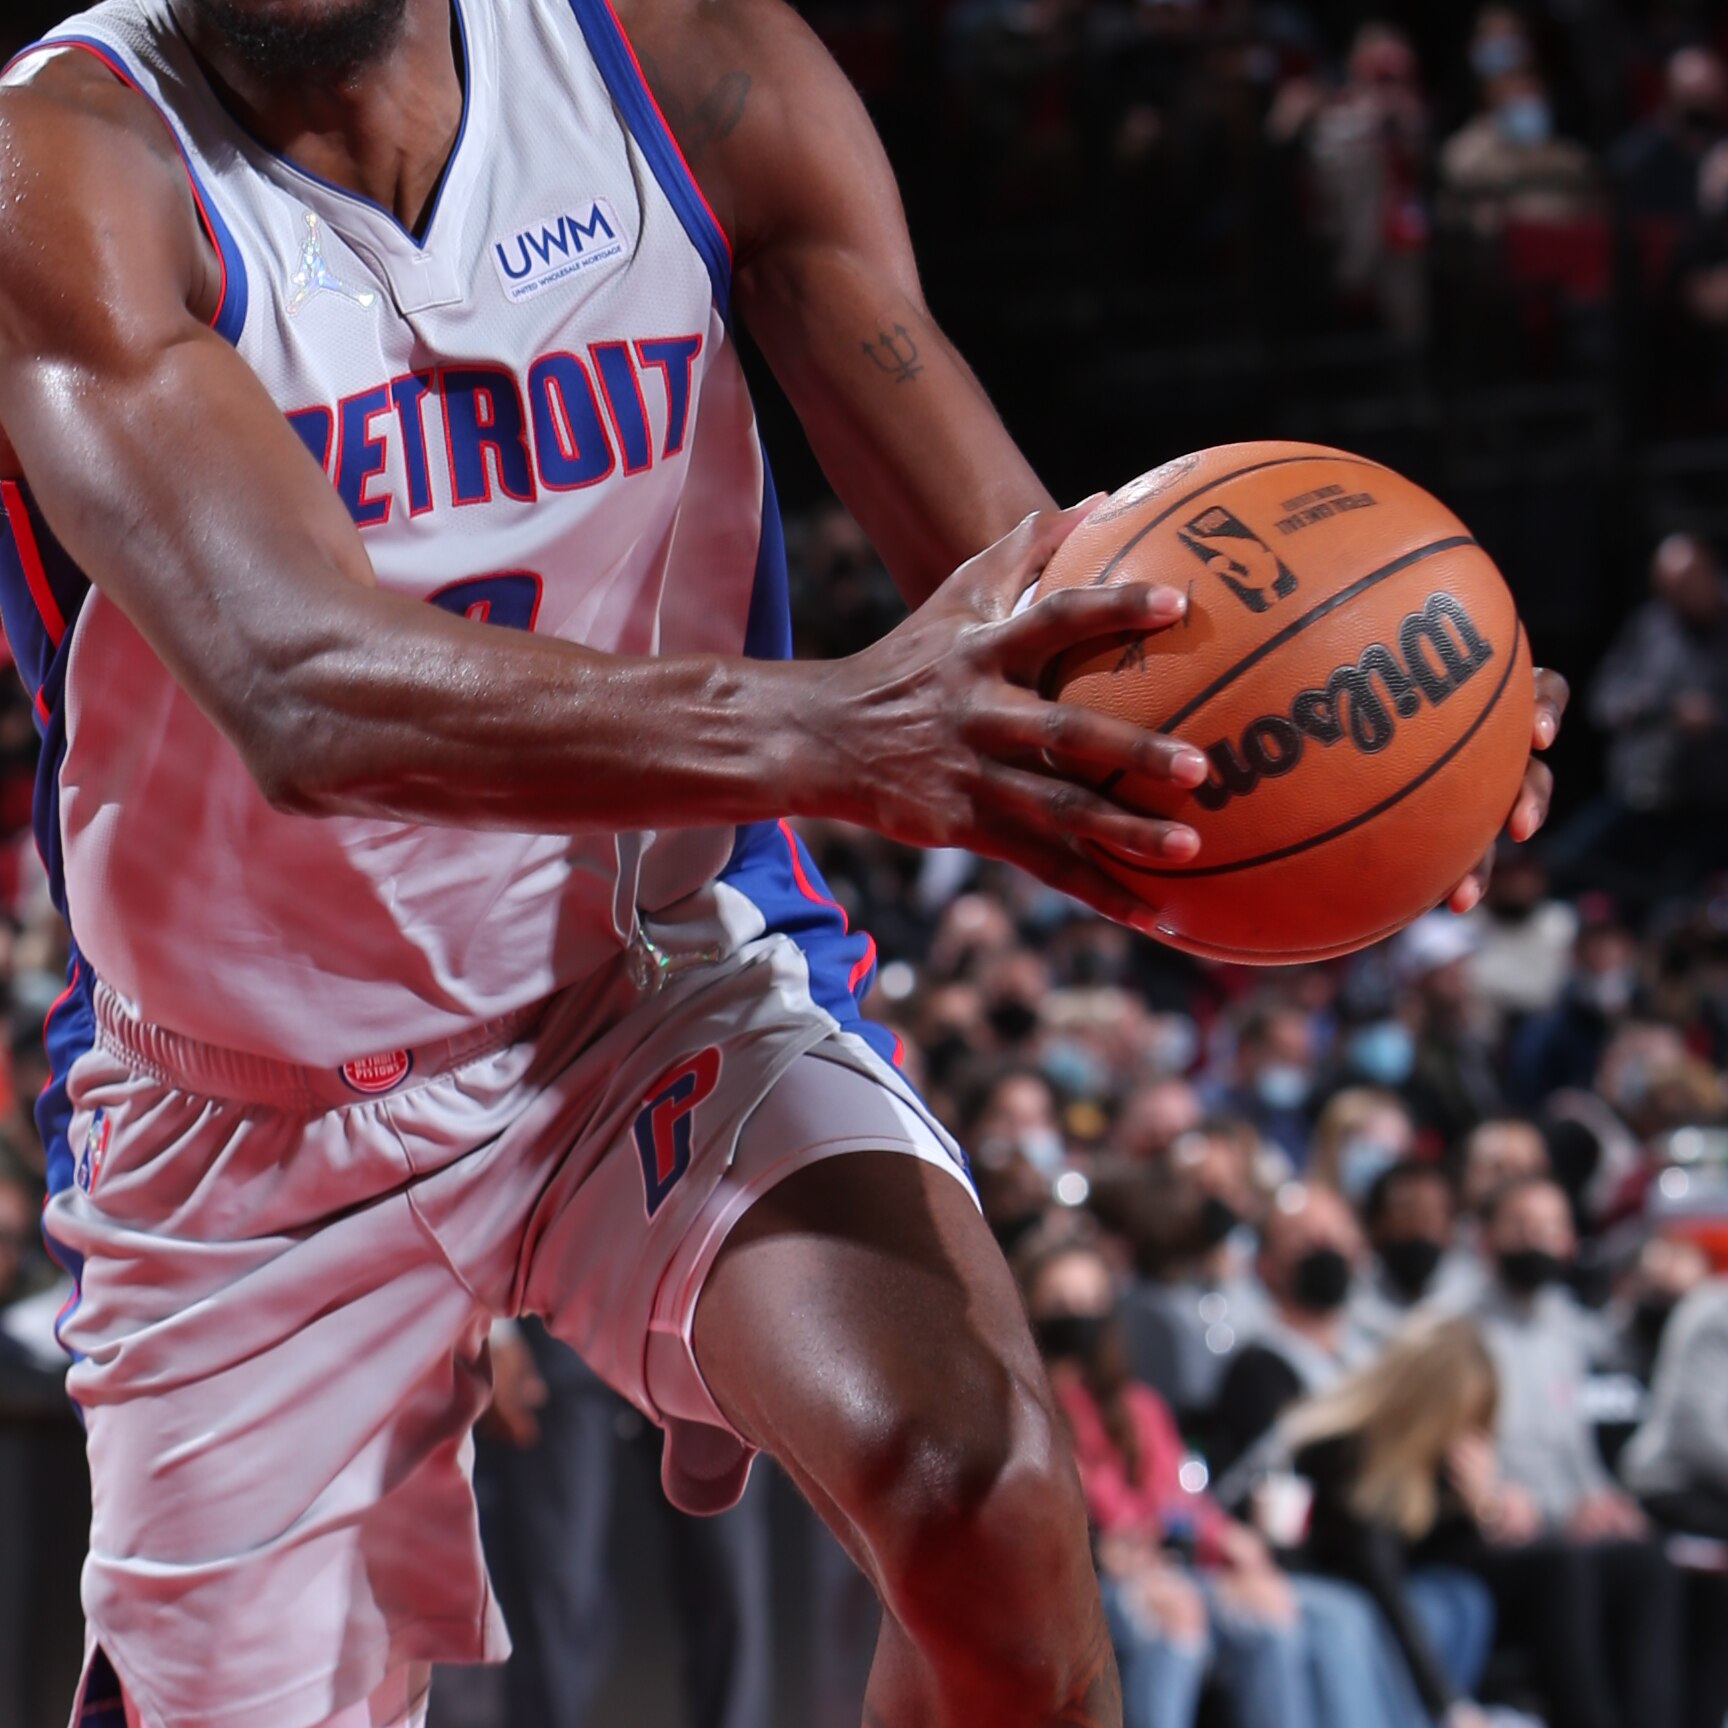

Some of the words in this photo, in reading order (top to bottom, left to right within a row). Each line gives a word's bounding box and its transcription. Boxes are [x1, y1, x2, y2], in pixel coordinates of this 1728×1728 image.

[495, 202, 616, 280] UWM
[512, 282, 539, 298] UNITED
[538, 261, 581, 287] WHOLESALE
[1190, 590, 1494, 812] Wilson
